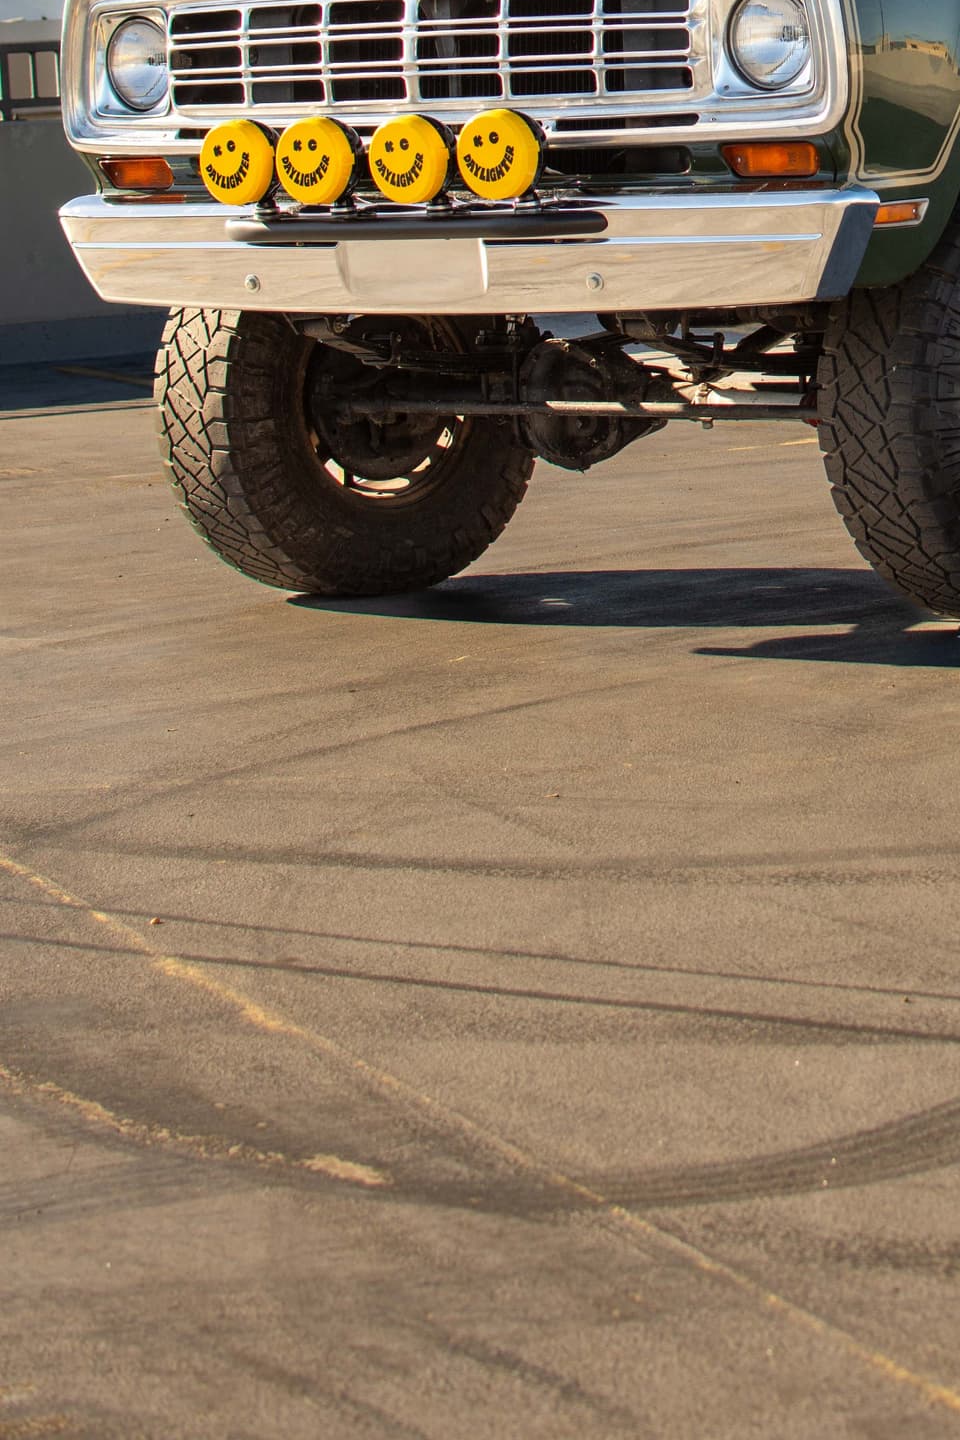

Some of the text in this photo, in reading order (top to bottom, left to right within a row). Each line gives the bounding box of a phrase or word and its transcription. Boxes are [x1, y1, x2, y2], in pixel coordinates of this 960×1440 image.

[206, 152, 249, 189] DAYLIGHTER
[281, 155, 330, 187] DAYLIGHTER
[374, 152, 424, 187] DAYLIGHTER
[463, 145, 514, 182] DAYLIGHTER
